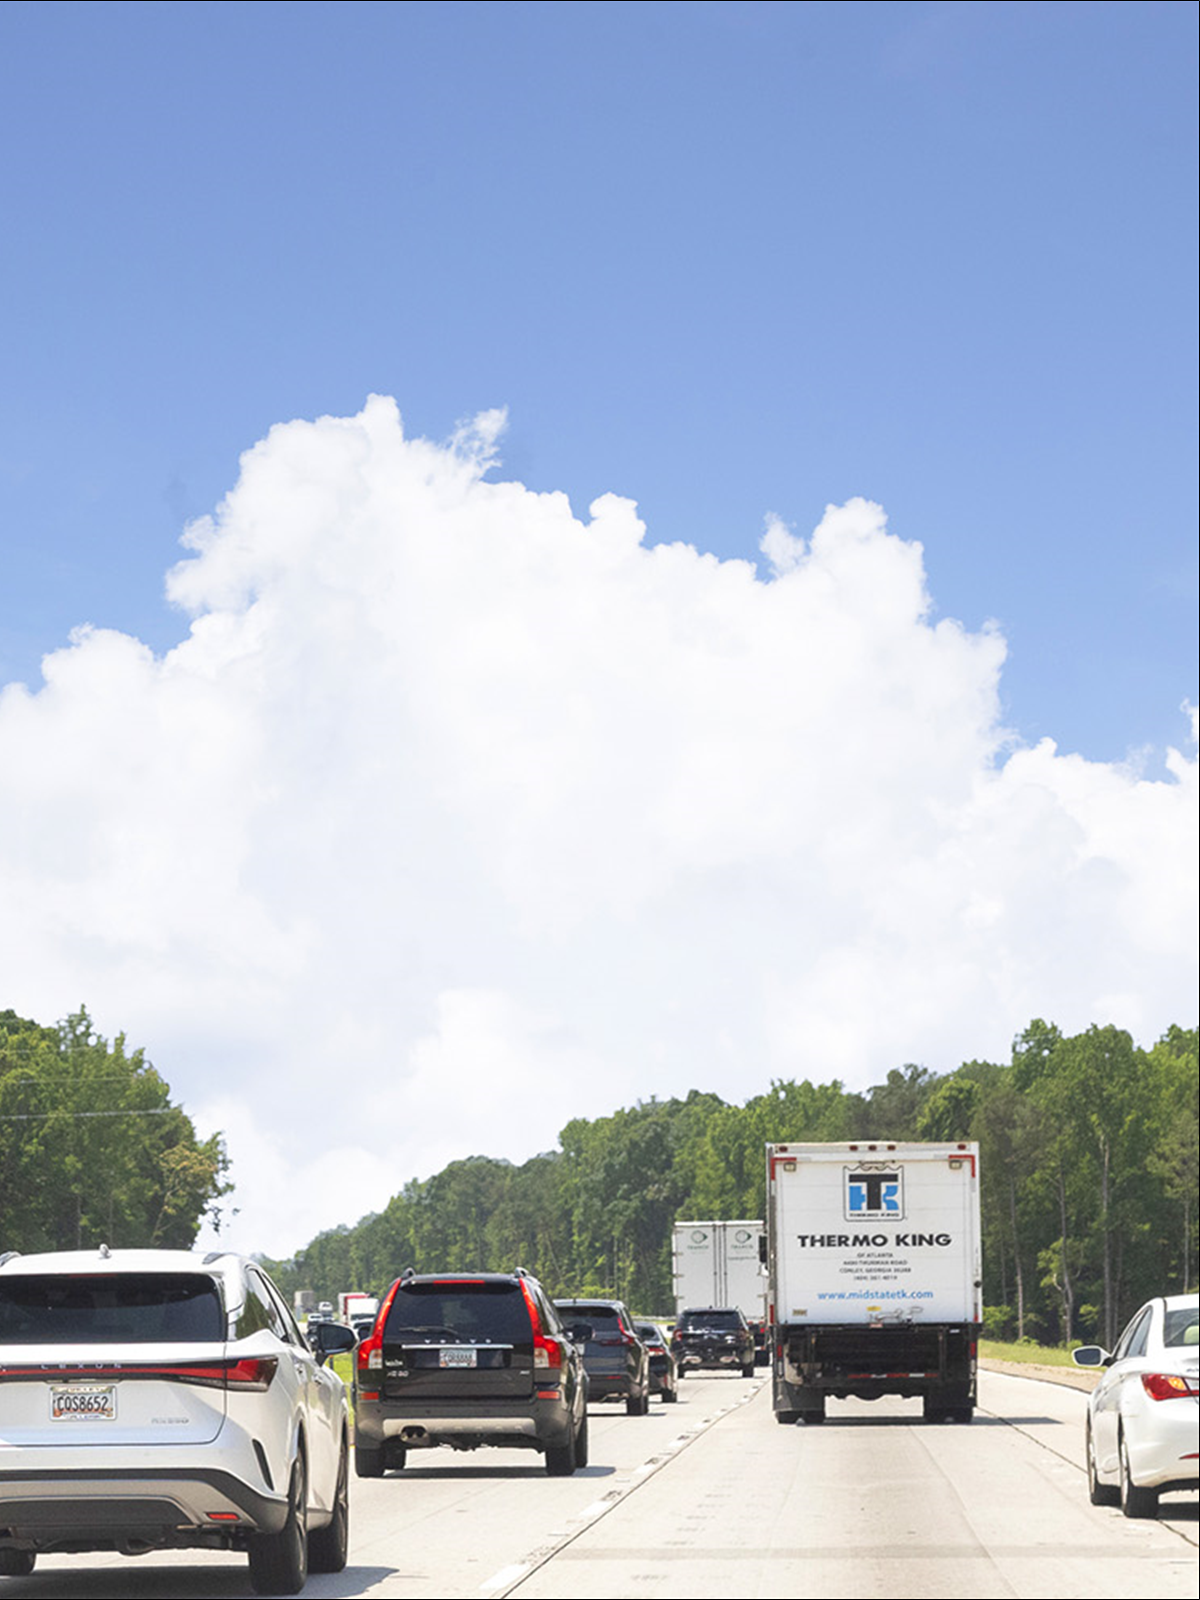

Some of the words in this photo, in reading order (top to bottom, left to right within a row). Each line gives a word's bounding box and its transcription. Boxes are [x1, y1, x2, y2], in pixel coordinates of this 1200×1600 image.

[797, 1234, 888, 1248] THERMO
[895, 1233, 952, 1247] KING
[816, 1289, 934, 1300] www.midstatetk.com
